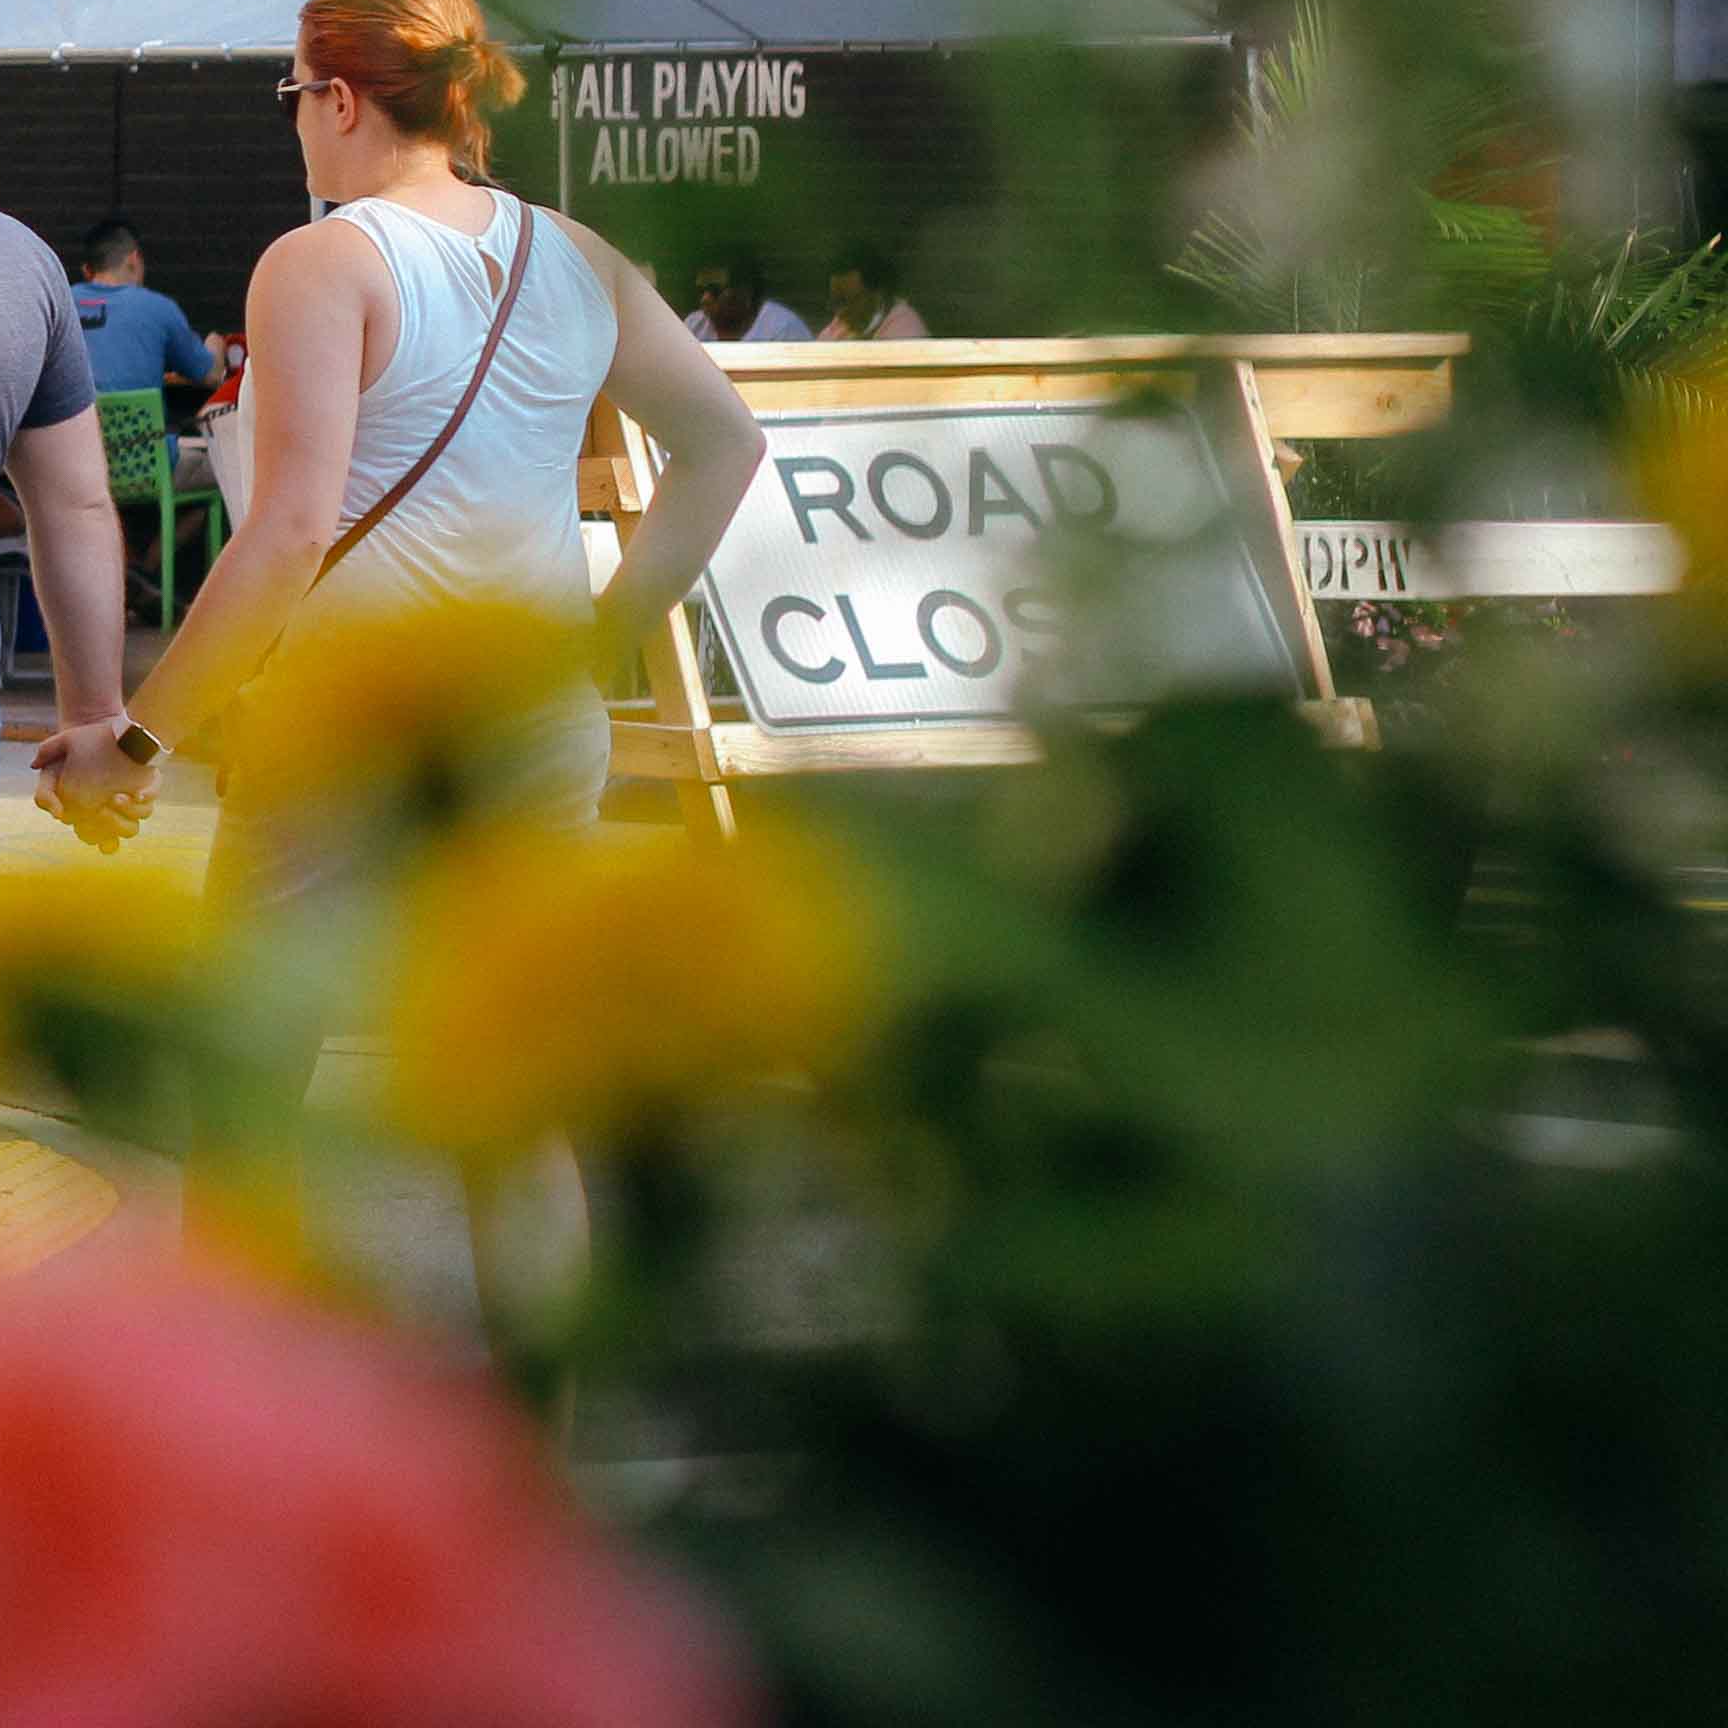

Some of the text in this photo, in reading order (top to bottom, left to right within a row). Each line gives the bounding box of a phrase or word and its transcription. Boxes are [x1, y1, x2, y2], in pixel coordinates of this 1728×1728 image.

[652, 59, 807, 119] PLAYING
[589, 125, 761, 185] ALLOWED
[774, 443, 1119, 545] ROAD
[761, 588, 1066, 685] CLOS
